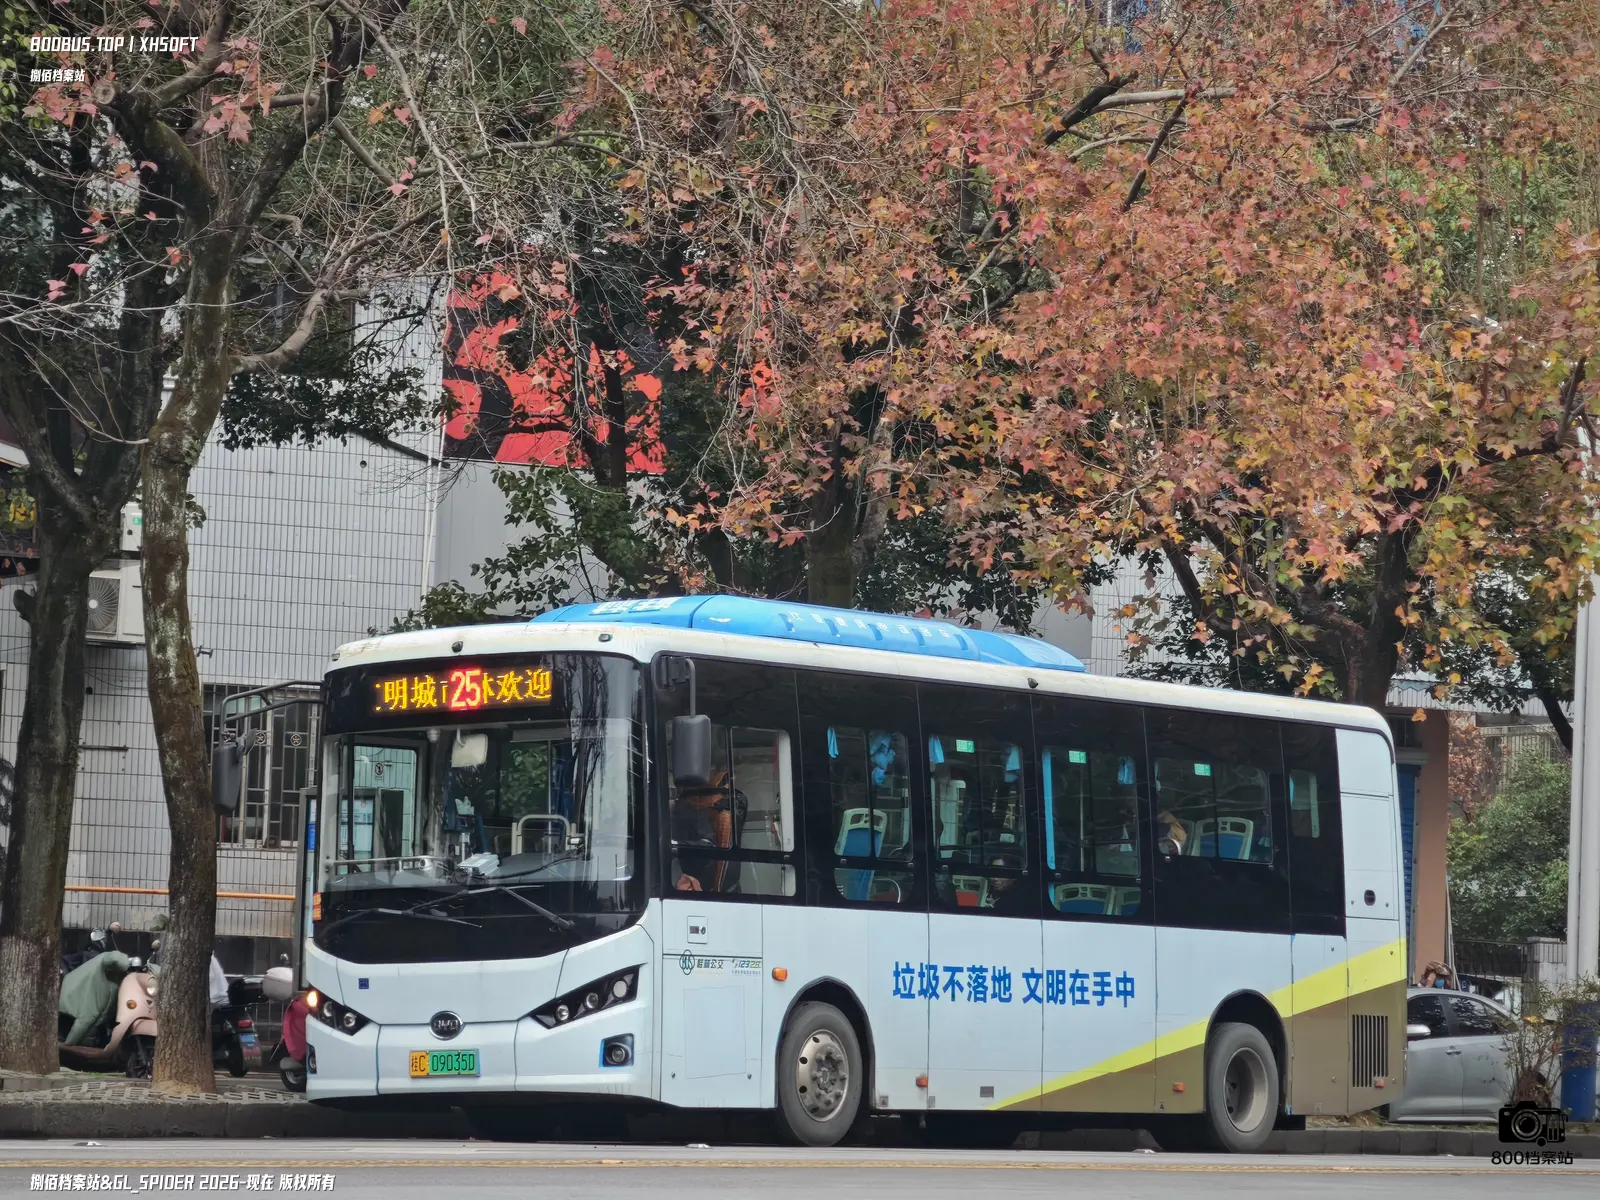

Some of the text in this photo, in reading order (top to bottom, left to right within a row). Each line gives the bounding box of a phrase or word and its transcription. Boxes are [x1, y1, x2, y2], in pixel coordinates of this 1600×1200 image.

[375, 674, 448, 711] 明城
[450, 669, 482, 709] 25
[893, 961, 1135, 1008] 垃圾不落地 文明在手中
